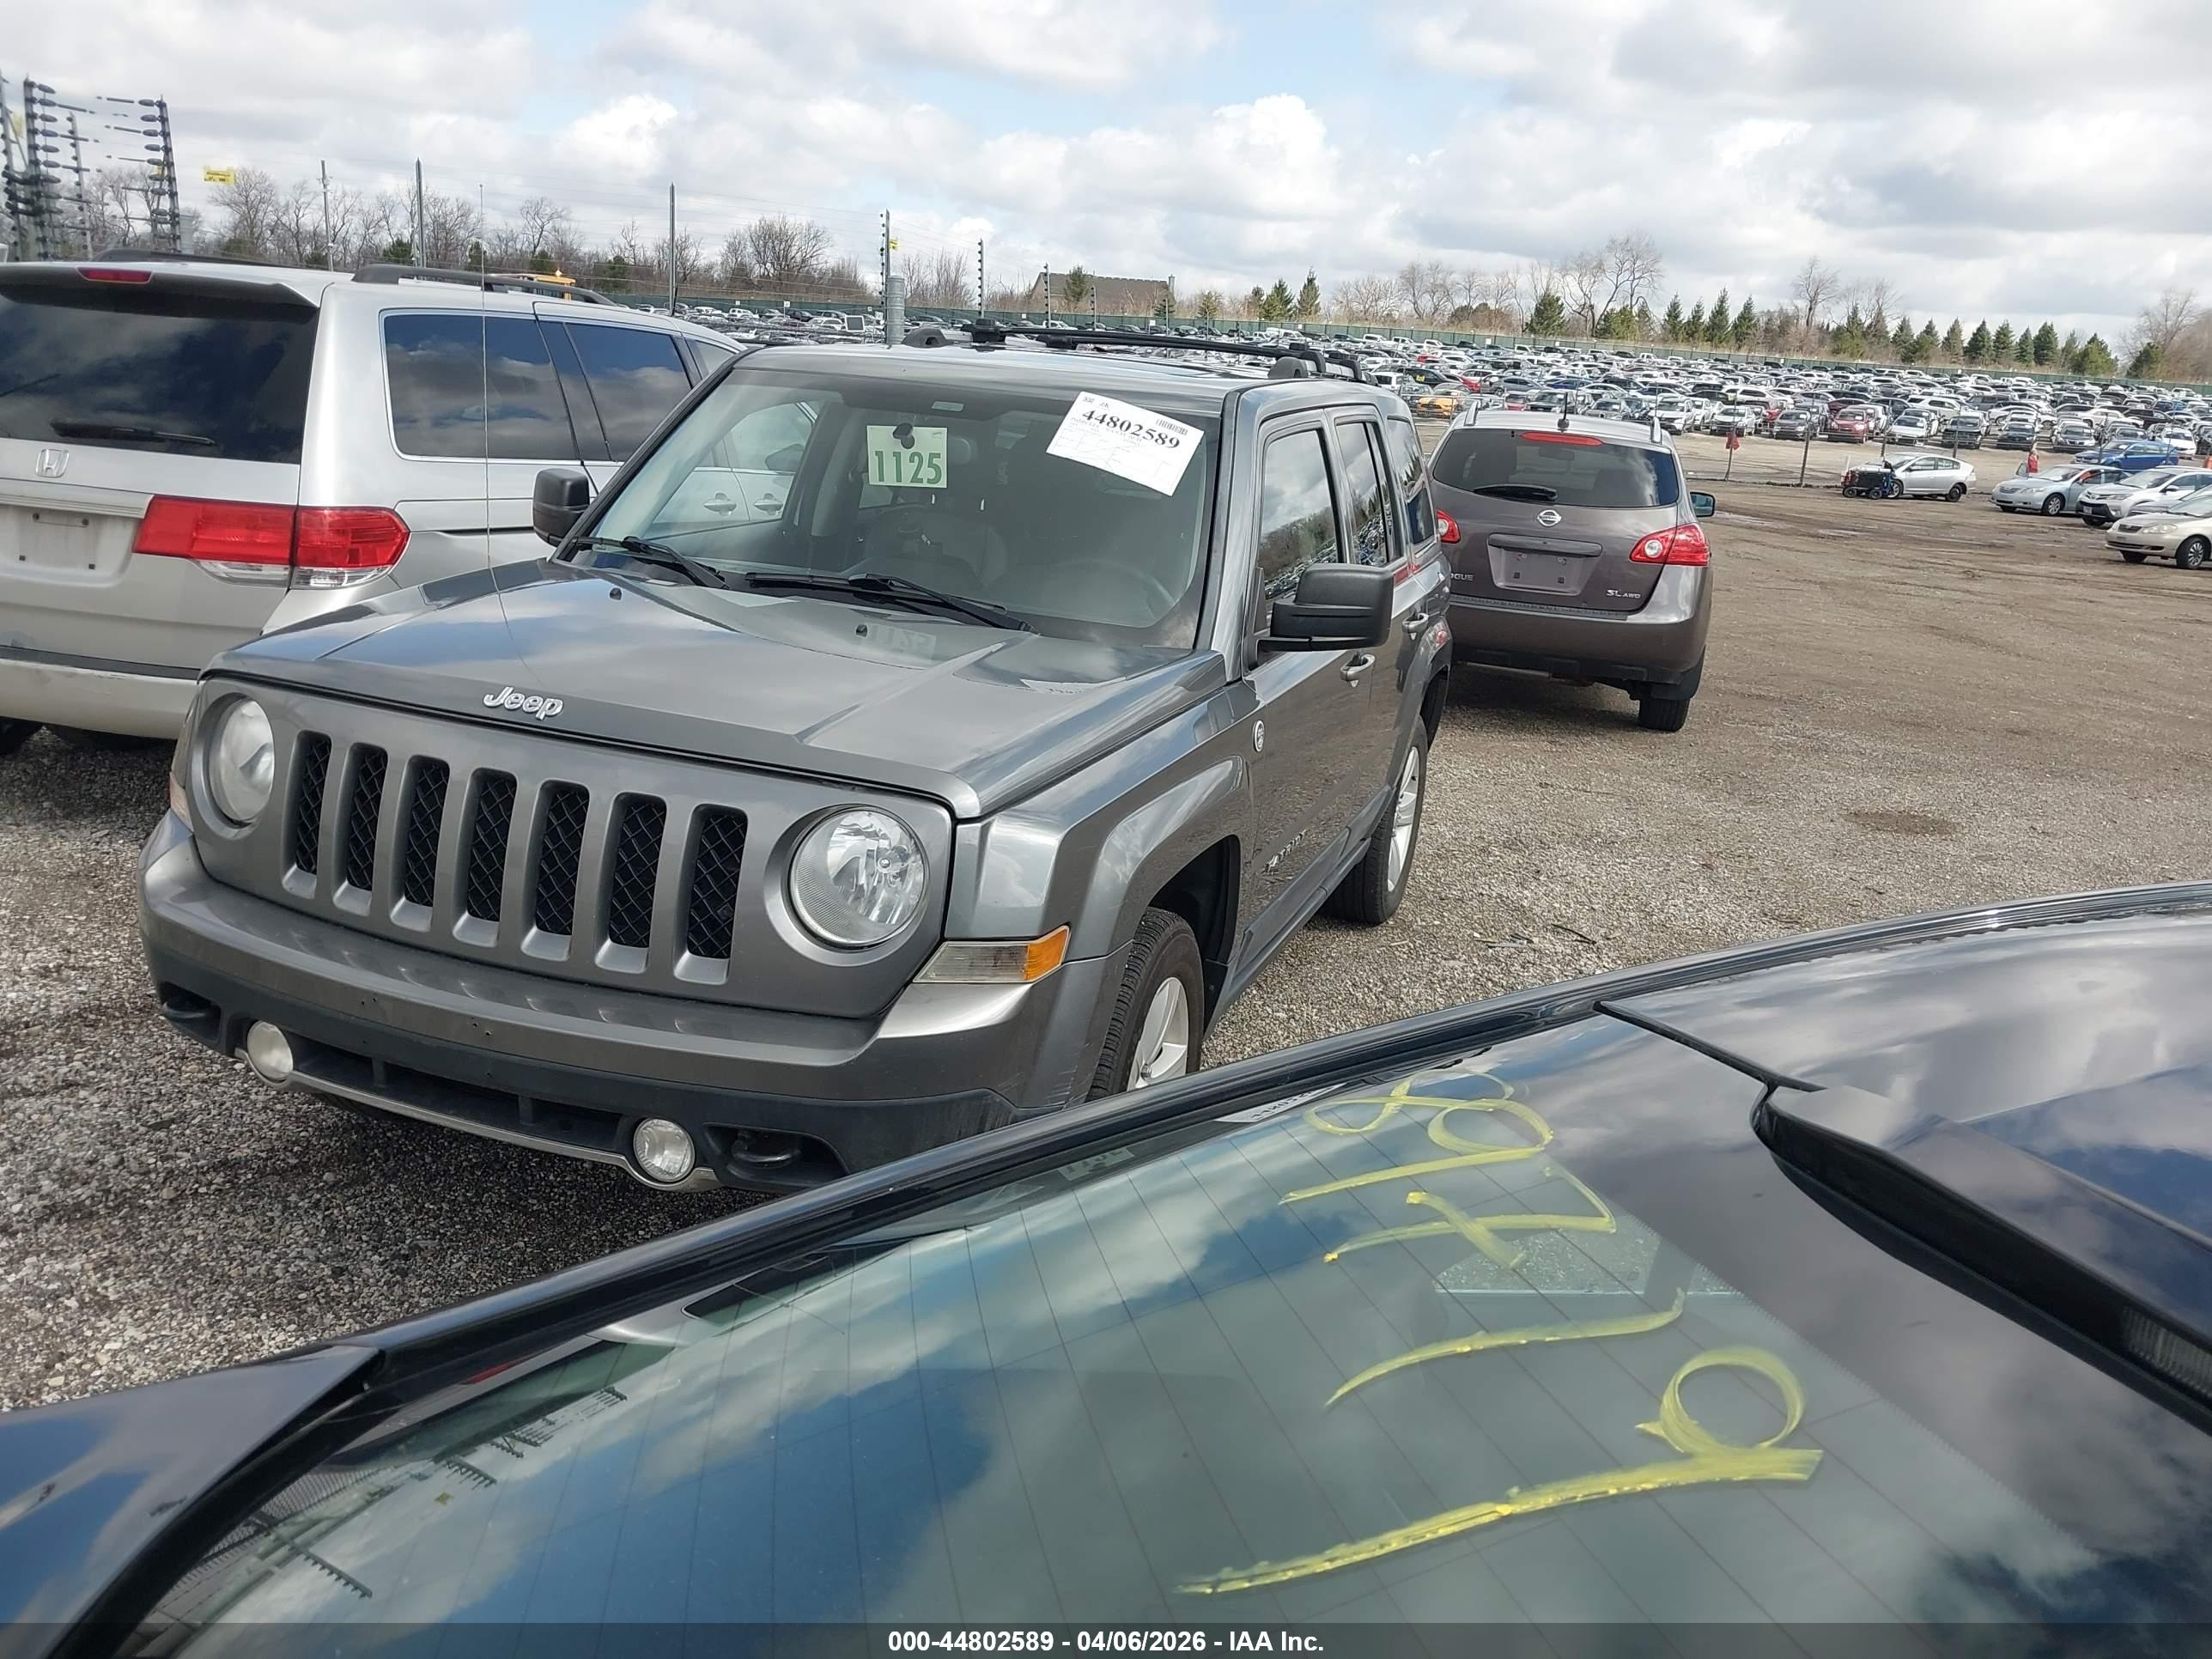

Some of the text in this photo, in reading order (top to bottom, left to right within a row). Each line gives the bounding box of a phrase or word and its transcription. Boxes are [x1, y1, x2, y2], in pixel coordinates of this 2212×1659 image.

[1083, 410, 1180, 448] 44802589
[874, 450, 942, 485] 1125
[483, 686, 563, 721] Jeep
